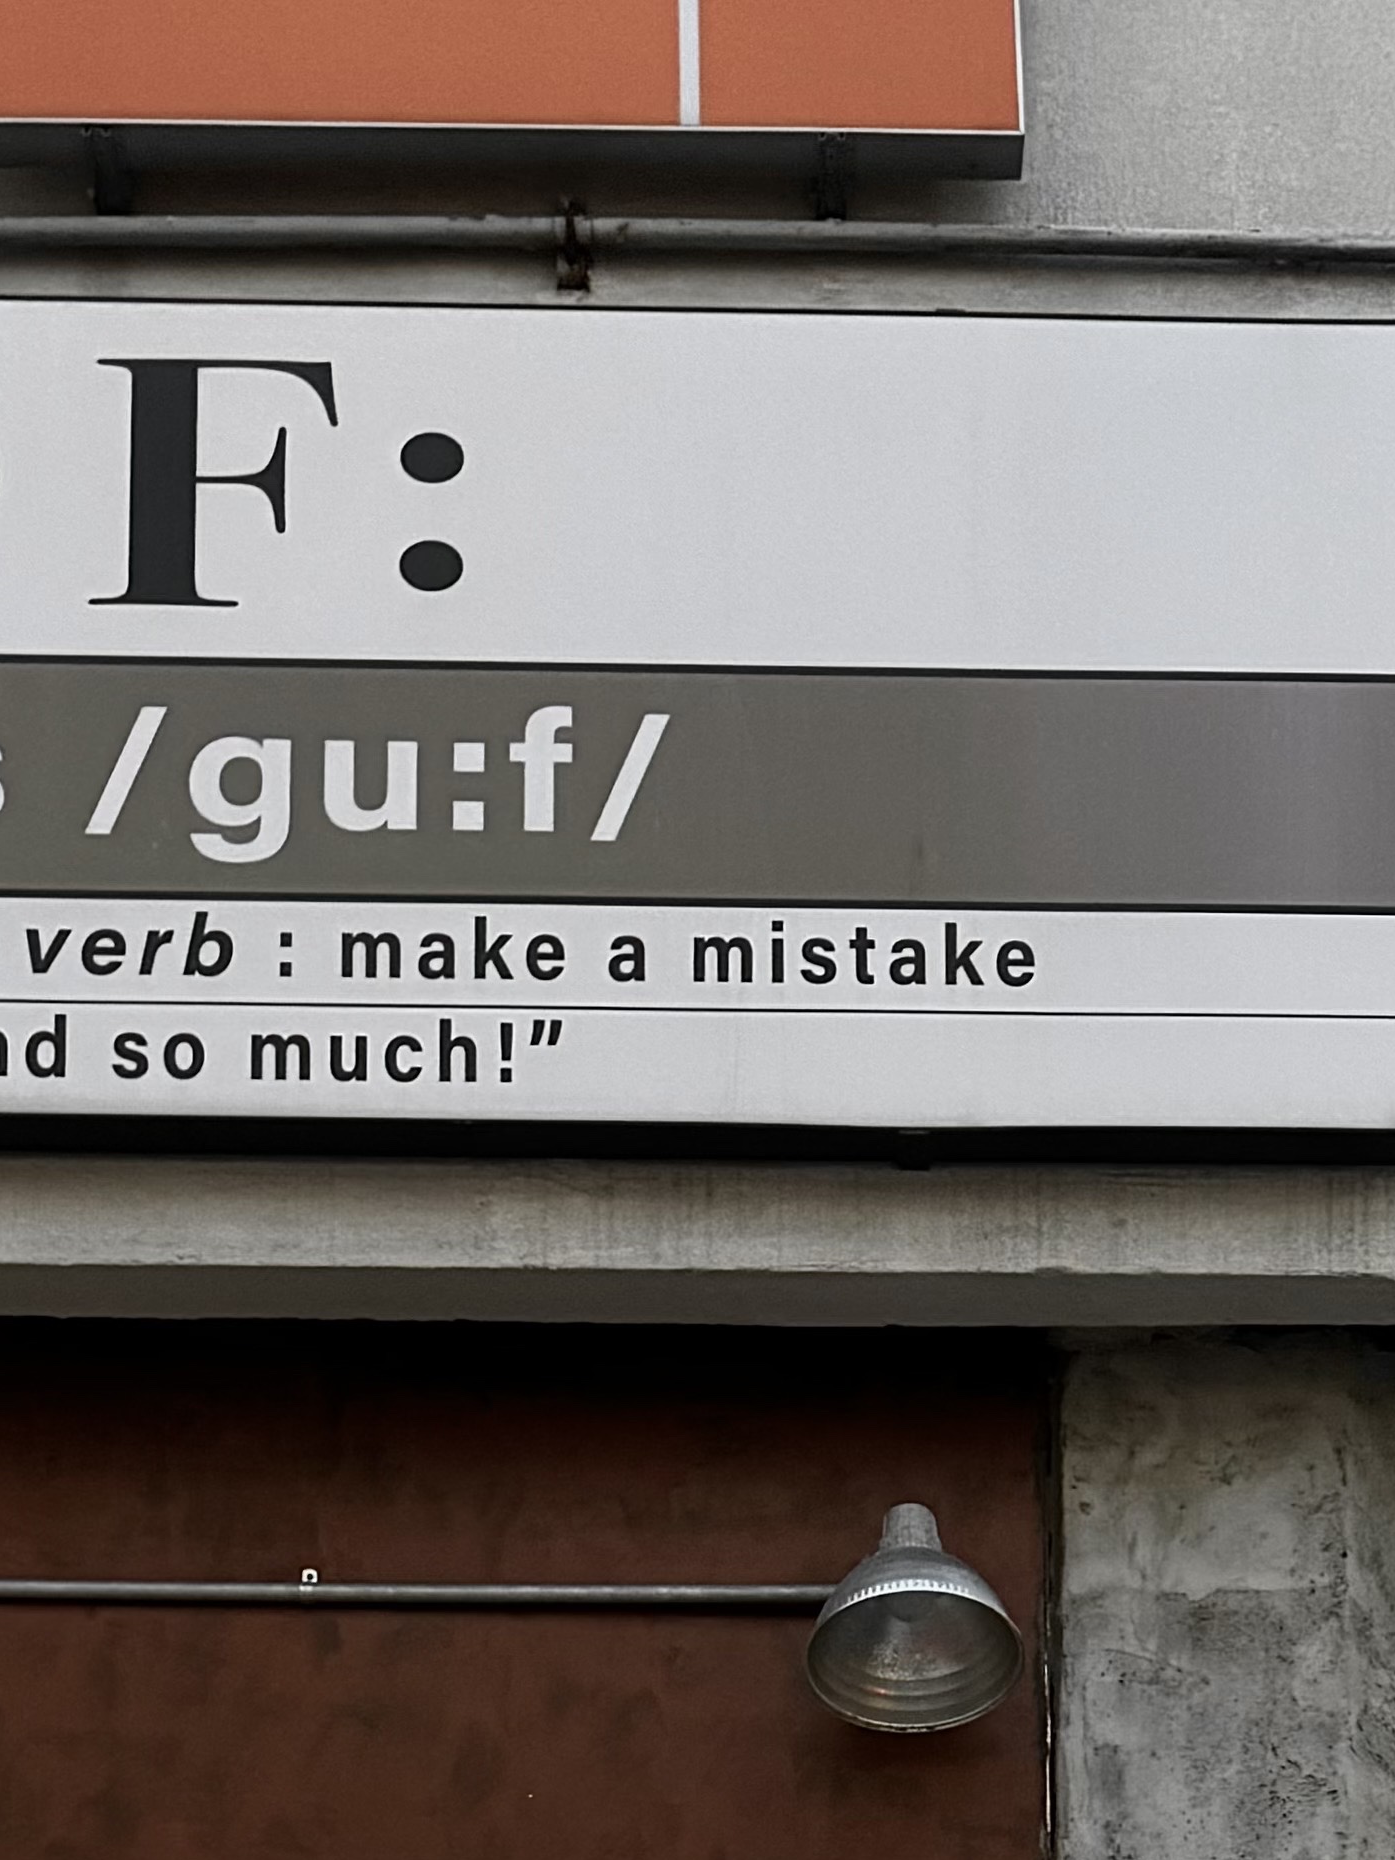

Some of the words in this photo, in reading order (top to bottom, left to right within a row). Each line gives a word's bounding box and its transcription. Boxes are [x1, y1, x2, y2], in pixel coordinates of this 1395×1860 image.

[86, 706, 671, 862] /gu:f/
[26, 912, 233, 977] verb
[342, 916, 564, 981] make
[609, 936, 646, 982] a
[694, 921, 1035, 988] mistake
[112, 1033, 204, 1079] so
